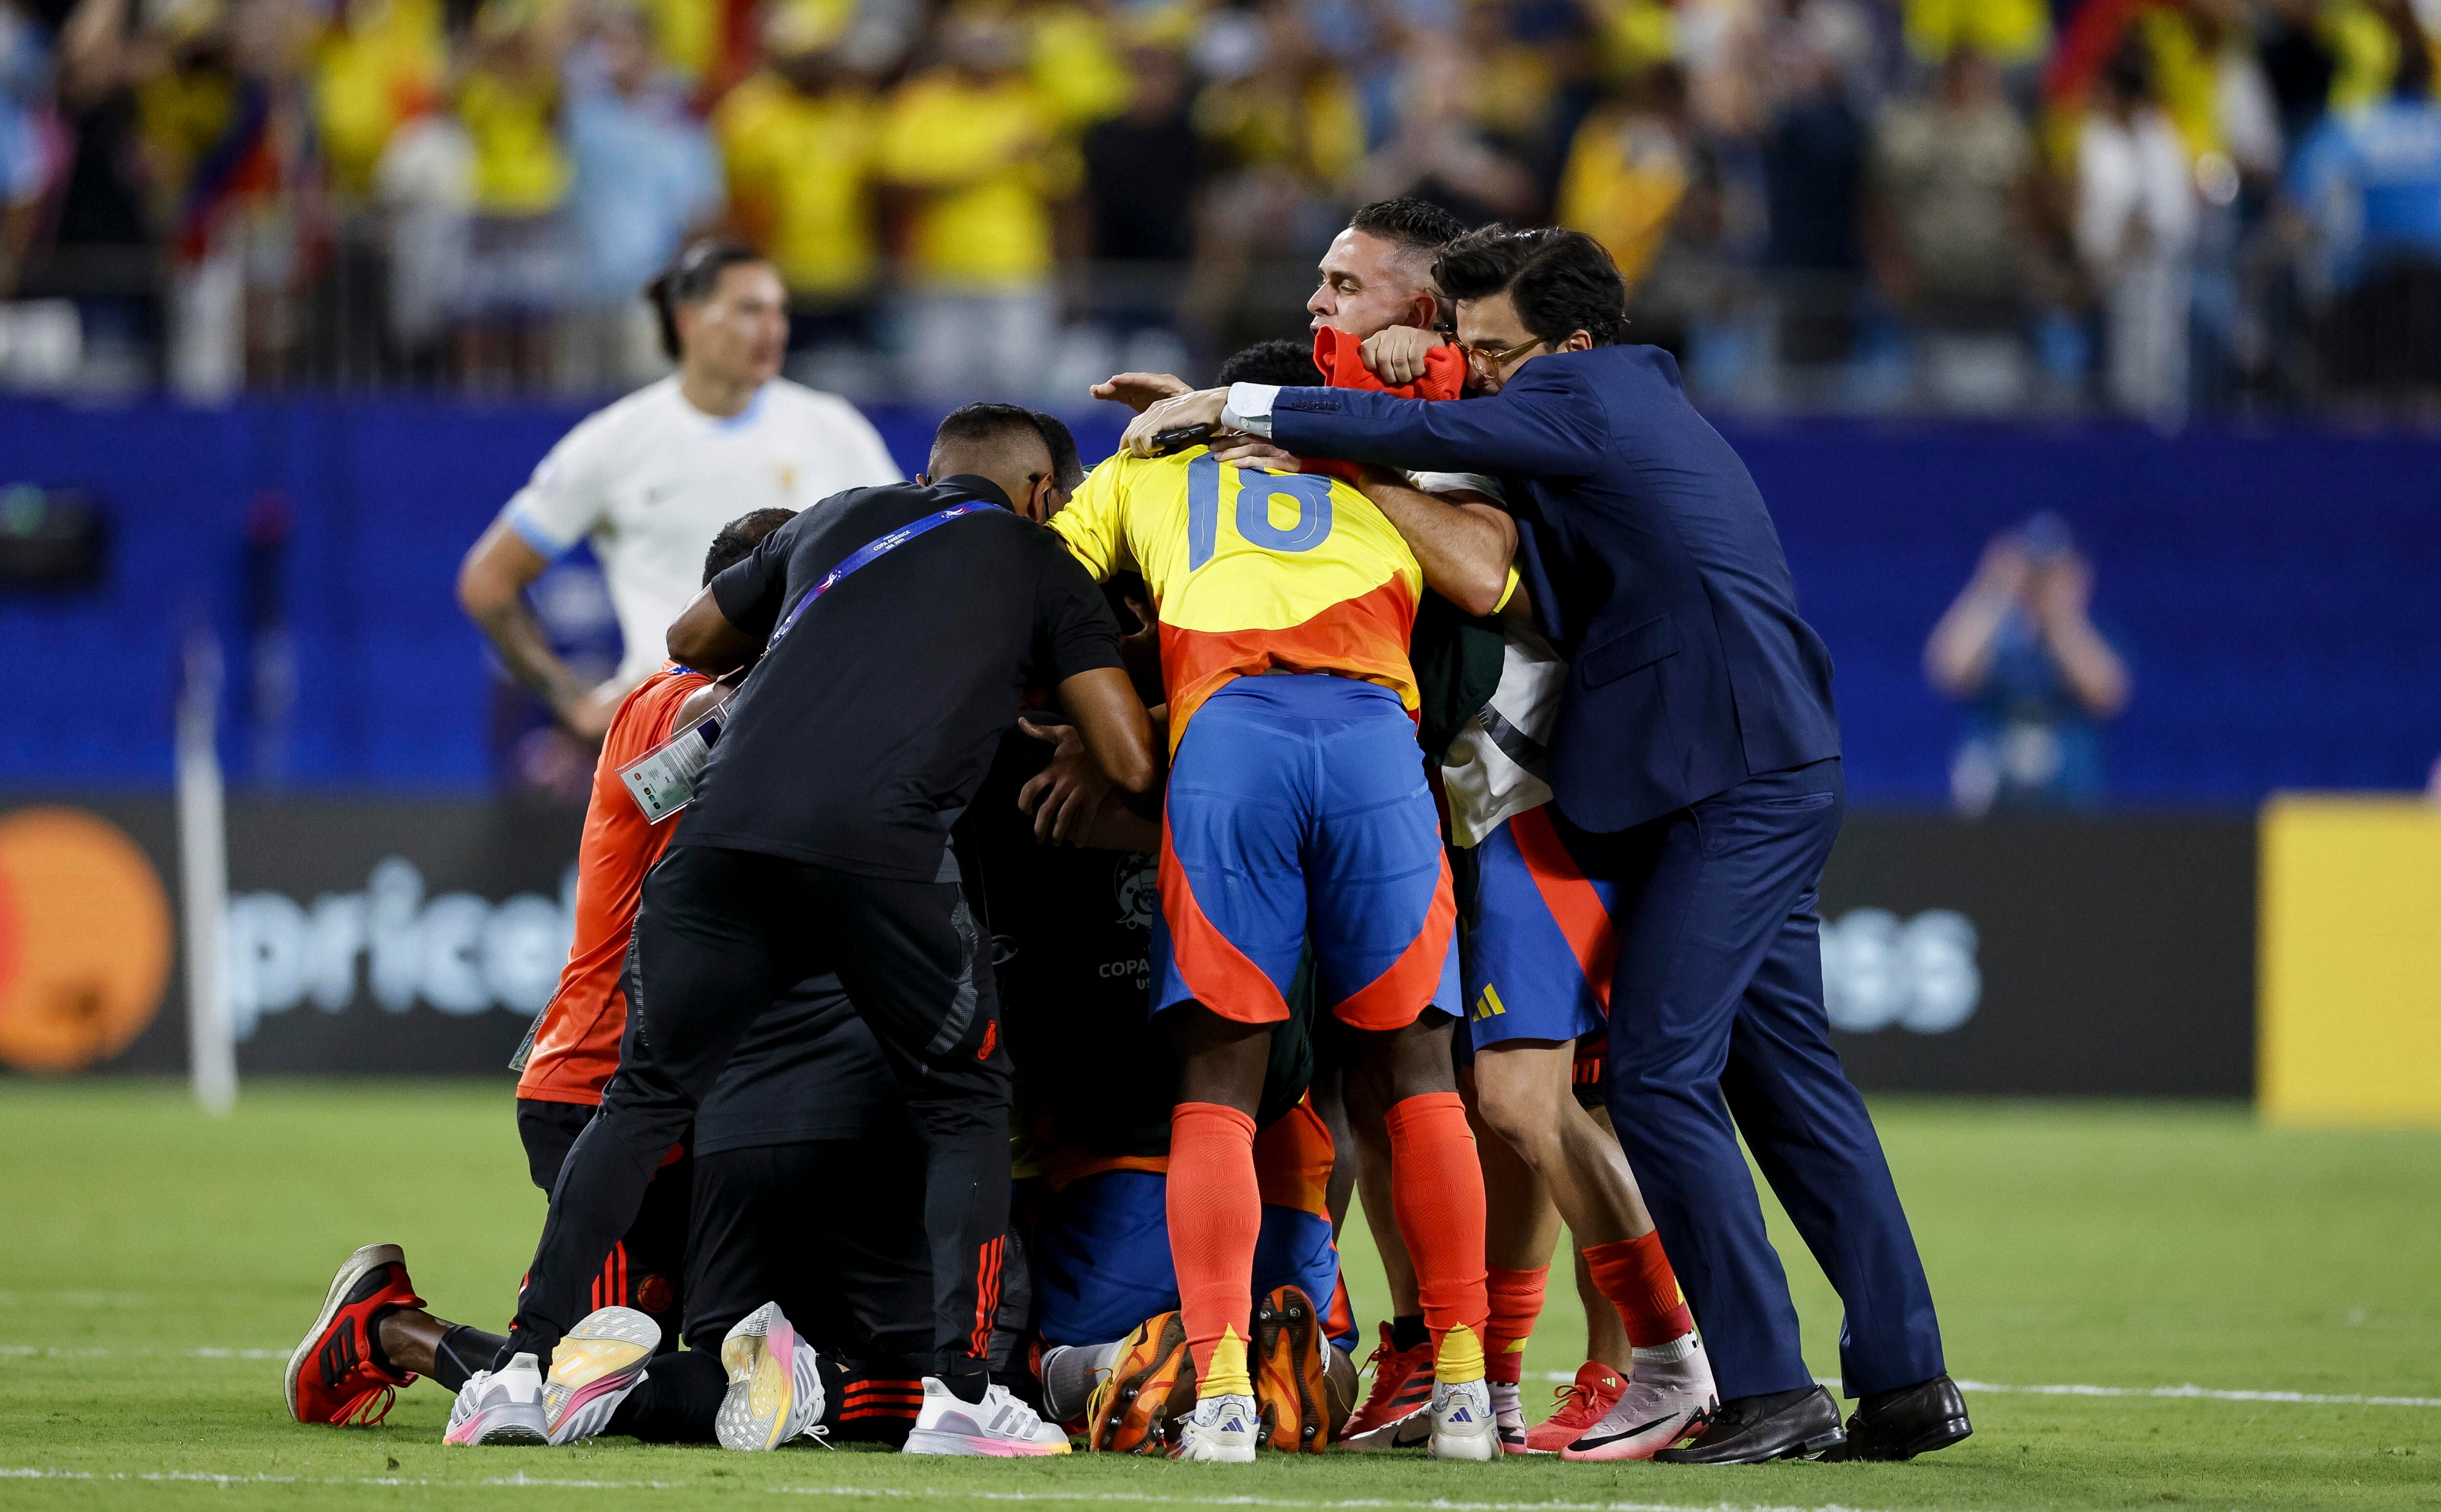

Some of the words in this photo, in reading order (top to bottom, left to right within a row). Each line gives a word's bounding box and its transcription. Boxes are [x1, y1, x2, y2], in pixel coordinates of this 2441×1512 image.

[1188, 451, 1333, 572] 18
[873, 541, 889, 551] COPA
[888, 530, 911, 543] AMERICA
[1099, 958, 1150, 978] COPA
